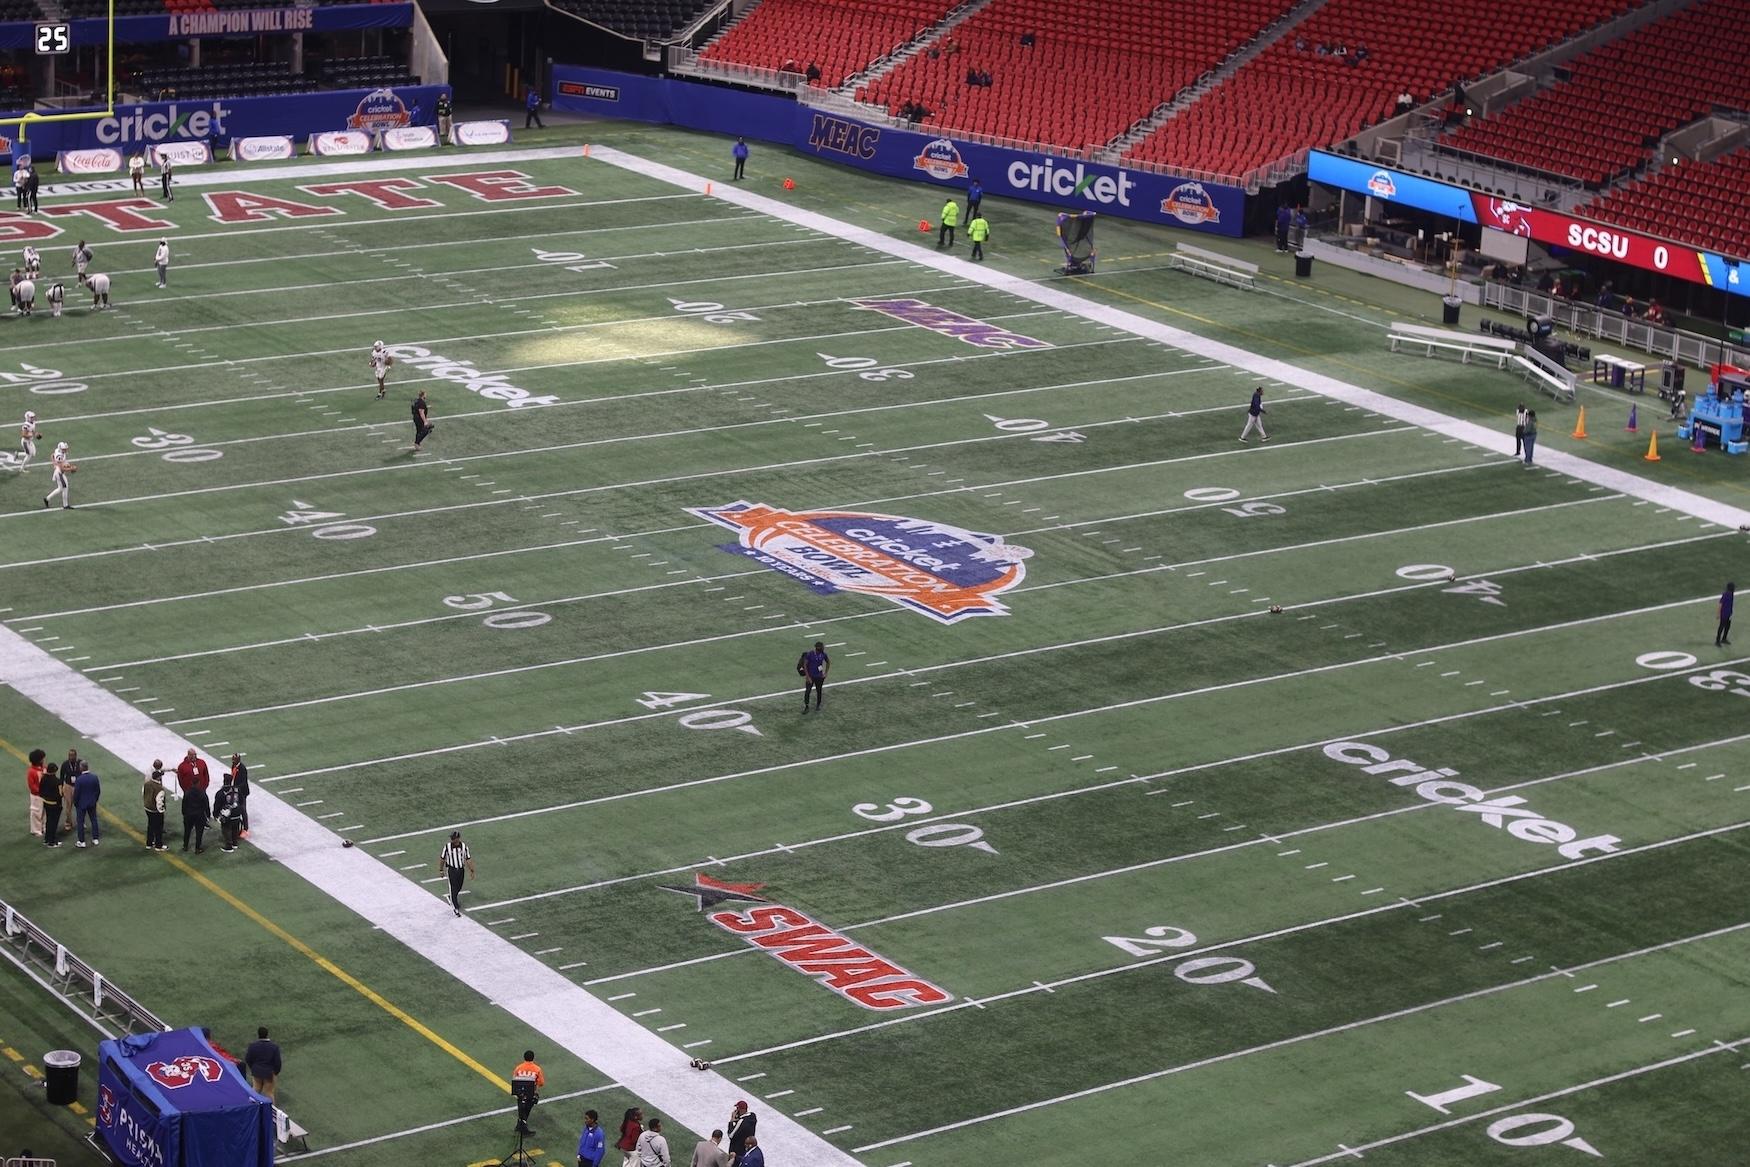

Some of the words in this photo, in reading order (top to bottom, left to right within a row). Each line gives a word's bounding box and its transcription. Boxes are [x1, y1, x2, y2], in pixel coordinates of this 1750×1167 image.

[38, 27, 68, 52] 25
[168, 15, 178, 36] A
[180, 12, 249, 35] CHAMPION
[251, 11, 282, 31] WILL
[284, 10, 313, 30] RISE
[367, 105, 393, 114] cricket
[585, 86, 616, 99] EVENTS
[96, 102, 226, 144] cricket
[808, 114, 880, 160] MEAC
[1007, 158, 1132, 207] cricket
[1567, 223, 1629, 259] SCSU
[1653, 246, 1669, 270] 0
[386, 345, 560, 409] cricket
[770, 562, 815, 581] YEARS
[775, 520, 961, 593] CELEBRATION
[784, 545, 873, 579] BOWL
[844, 528, 962, 572] cricket
[1322, 741, 1623, 860] cricket
[708, 904, 952, 1011] SWAC
[119, 1107, 163, 1165] PRISMA
